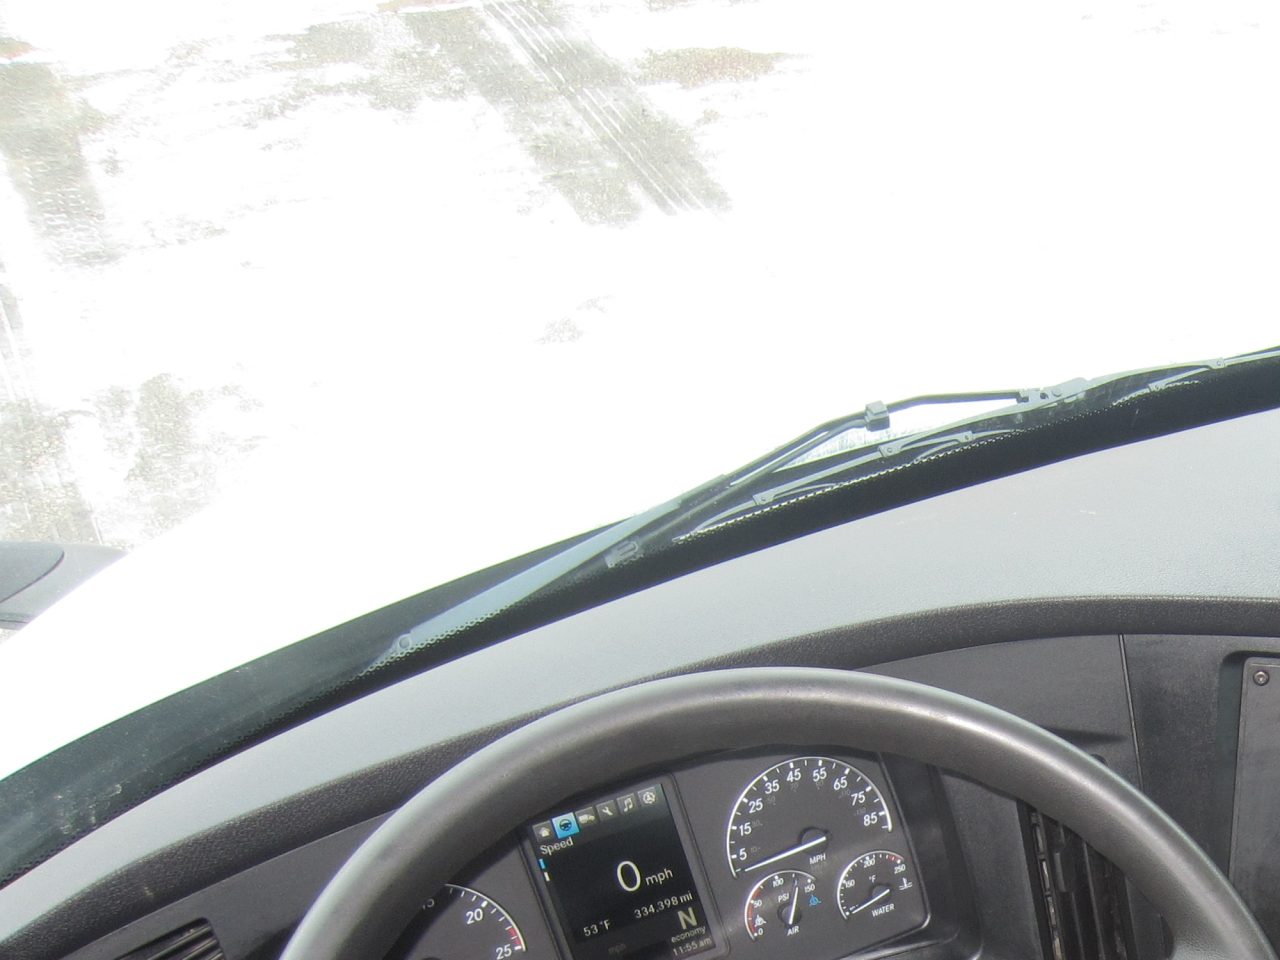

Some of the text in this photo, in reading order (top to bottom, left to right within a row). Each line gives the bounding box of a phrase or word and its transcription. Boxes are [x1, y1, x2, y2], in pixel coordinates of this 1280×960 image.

[786, 767, 801, 783] 45
[812, 767, 828, 782] 55
[764, 779, 780, 795] 35
[833, 775, 848, 791] 65
[748, 798, 763, 814] 25
[851, 791, 866, 806] 75
[863, 812, 878, 827] 85
[739, 822, 752, 837] 15
[540, 837, 574, 855] Speed
[739, 847, 748, 861] 5
[809, 854, 826, 865] MPH
[863, 858, 876, 868] 200
[894, 864, 906, 874] 250
[616, 860, 673, 892] 0 mph
[772, 879, 784, 888] 100
[845, 879, 855, 888] 150
[804, 883, 815, 894] 150
[680, 891, 693, 903] mi
[753, 900, 763, 908] 50
[778, 893, 790, 903] PSI
[465, 908, 484, 924] 20
[677, 906, 698, 930] N
[871, 903, 895, 918] WATER
[583, 925, 598, 937] 53
[671, 925, 706, 943] economy
[787, 926, 800, 936] AIR
[496, 944, 512, 960] 25
[672, 937, 712, 956] 11:55 am
